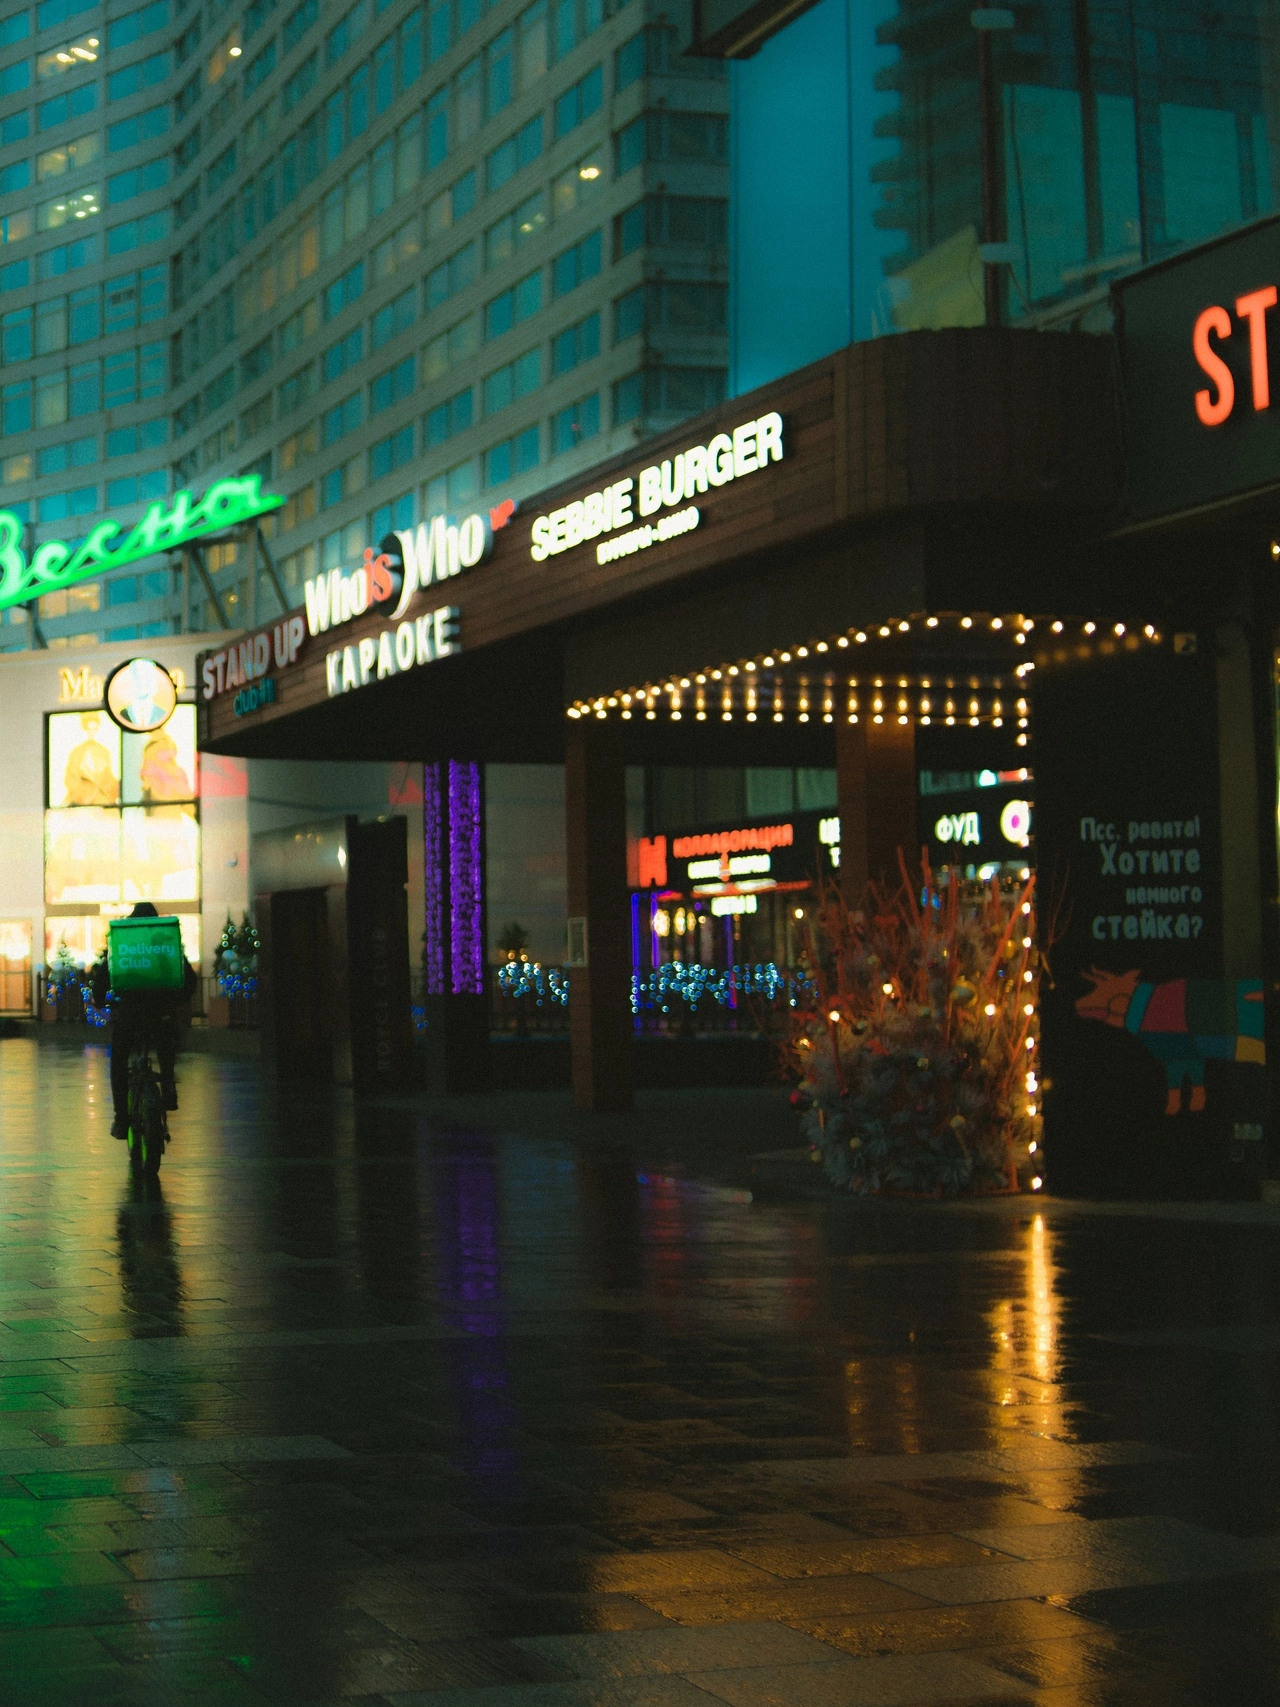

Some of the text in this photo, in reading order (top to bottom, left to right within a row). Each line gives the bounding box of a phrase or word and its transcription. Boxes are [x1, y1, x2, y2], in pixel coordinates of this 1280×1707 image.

[1193, 286, 1278, 427] ST
[531, 411, 784, 562] SEBBIE BURGER
[304, 566, 368, 637] Who
[363, 547, 393, 606] is
[403, 514, 486, 588] Who
[202, 631, 270, 701] STAND
[274, 615, 307, 669] UP
[935, 811, 981, 846] ФУД
[1100, 842, 1201, 876] Хотите
[1126, 885, 1203, 905] немного
[1093, 908, 1204, 940] стейка?
[119, 943, 176, 959] Delivery
[119, 957, 152, 969] Club
